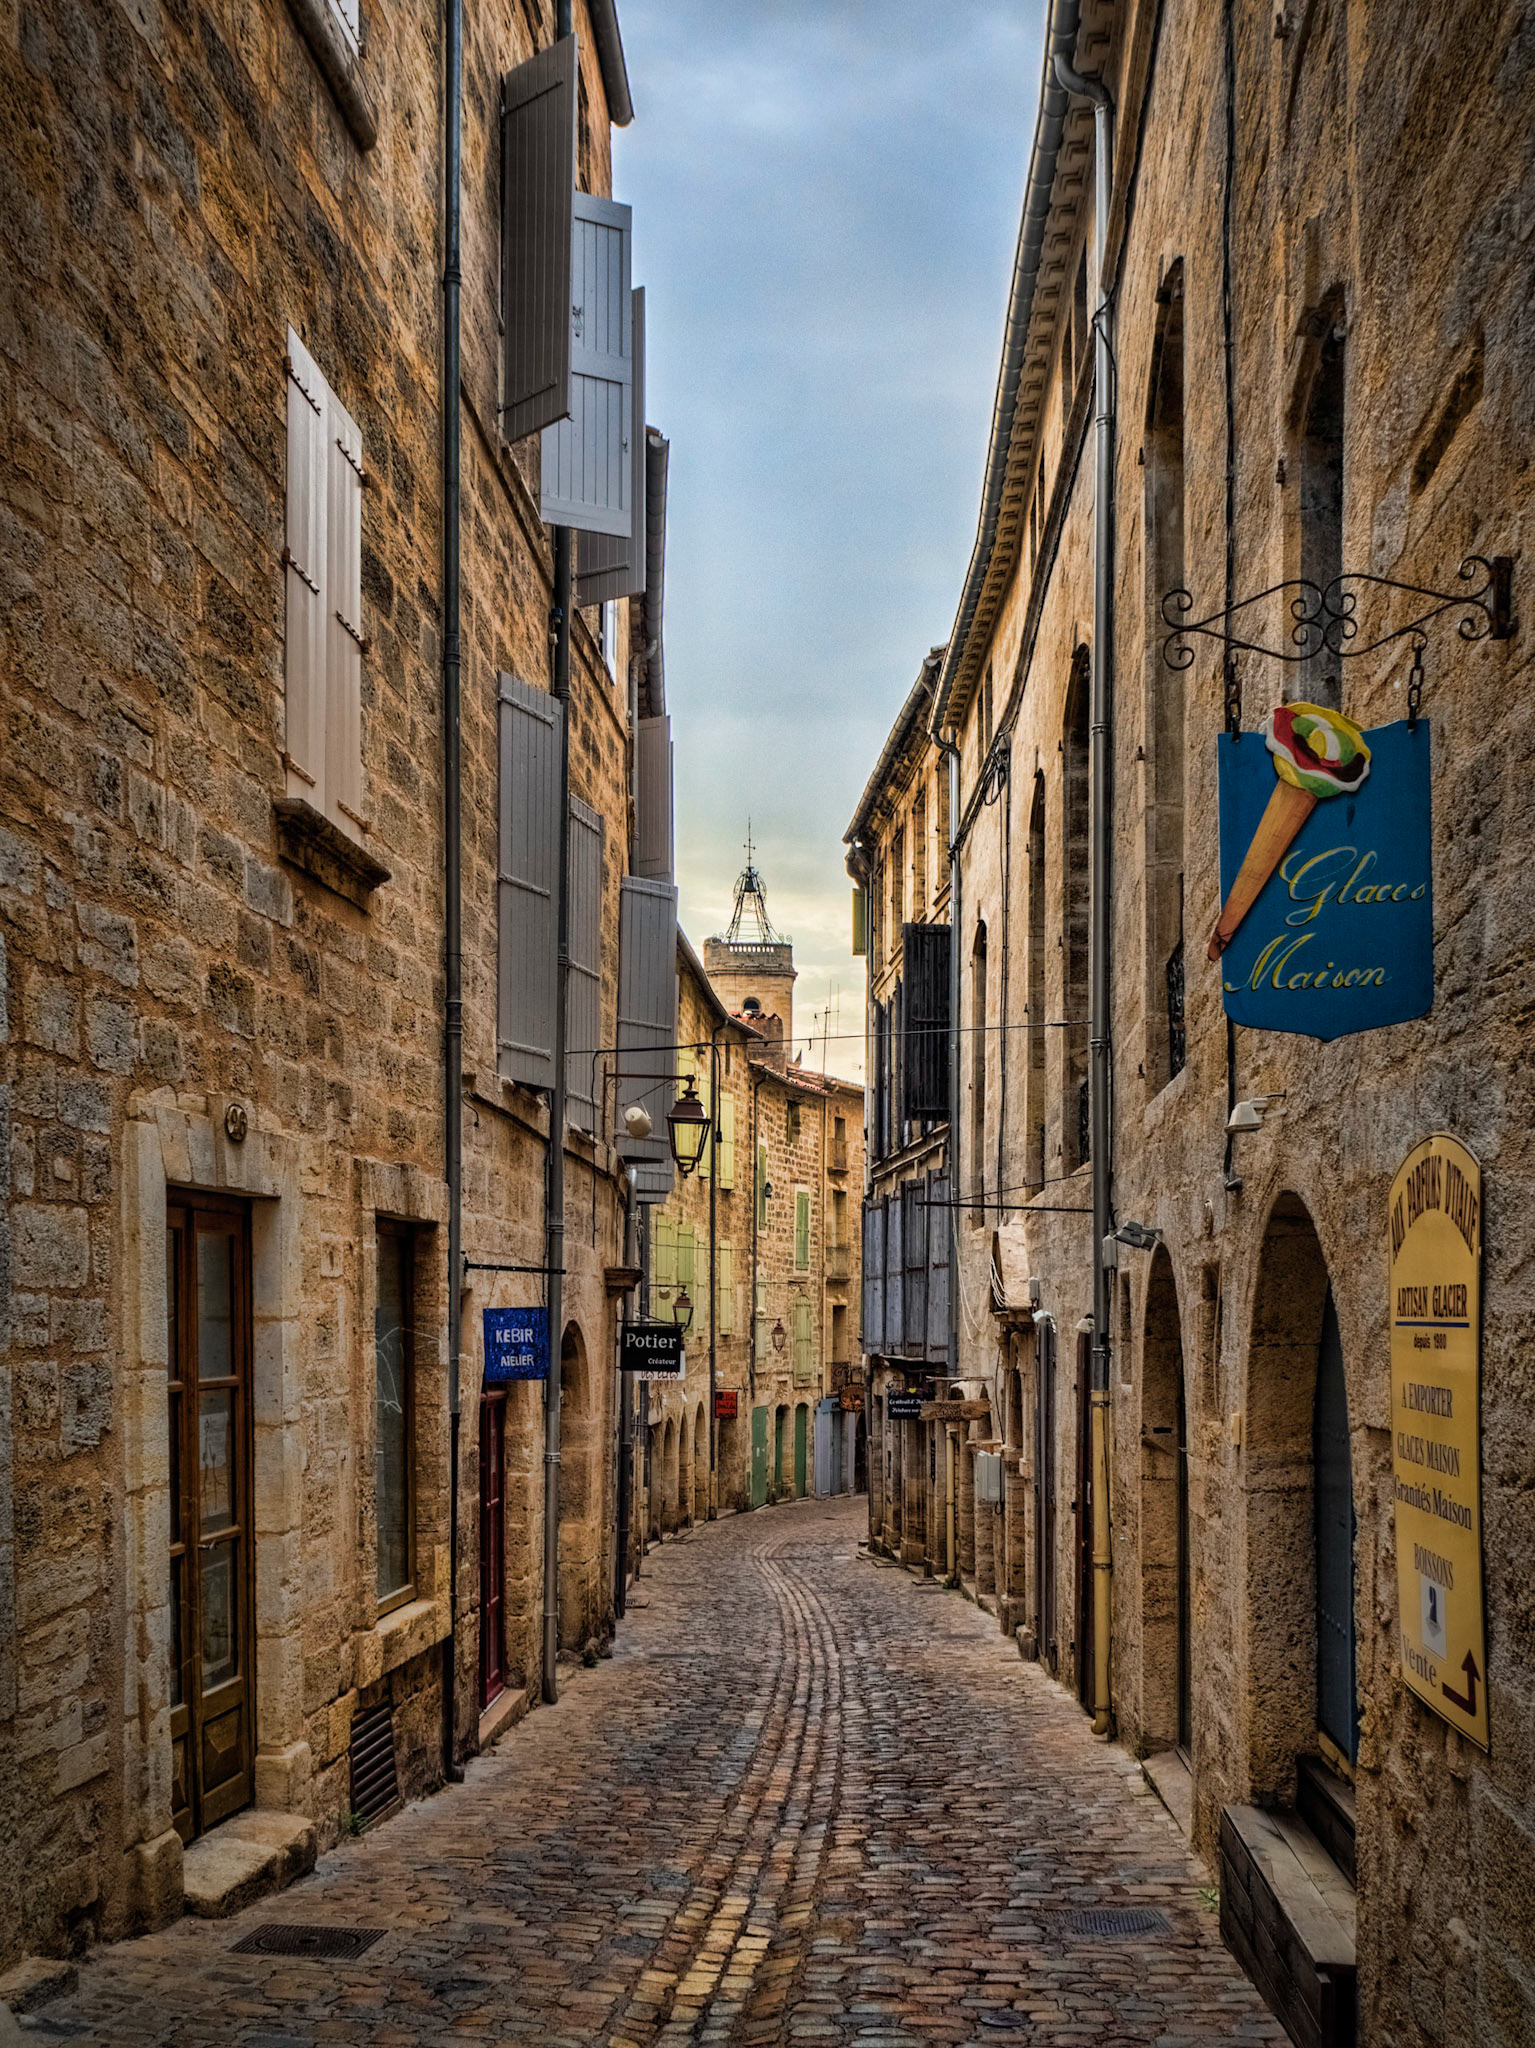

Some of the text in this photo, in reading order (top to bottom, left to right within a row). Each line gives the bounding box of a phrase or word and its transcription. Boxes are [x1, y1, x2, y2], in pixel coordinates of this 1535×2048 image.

[1279, 846, 1427, 926] Glaces
[1224, 932, 1392, 992] Maison
[1391, 1154, 1477, 1265] AUX PARFUMS D'ITALIE
[1397, 1284, 1467, 1318] ARTISAN GLACIER
[625, 1333, 677, 1349] Potier
[647, 1357, 677, 1365] Créateur
[1413, 1333, 1431, 1356] depuis
[1409, 1383, 1453, 1418] EMPORTER
[1397, 1432, 1460, 1478] GLACES MAISON
[1394, 1474, 1472, 1530] Granités Maison
[1414, 1542, 1453, 1591] BOISSONS
[1401, 1634, 1437, 1689] Vente
